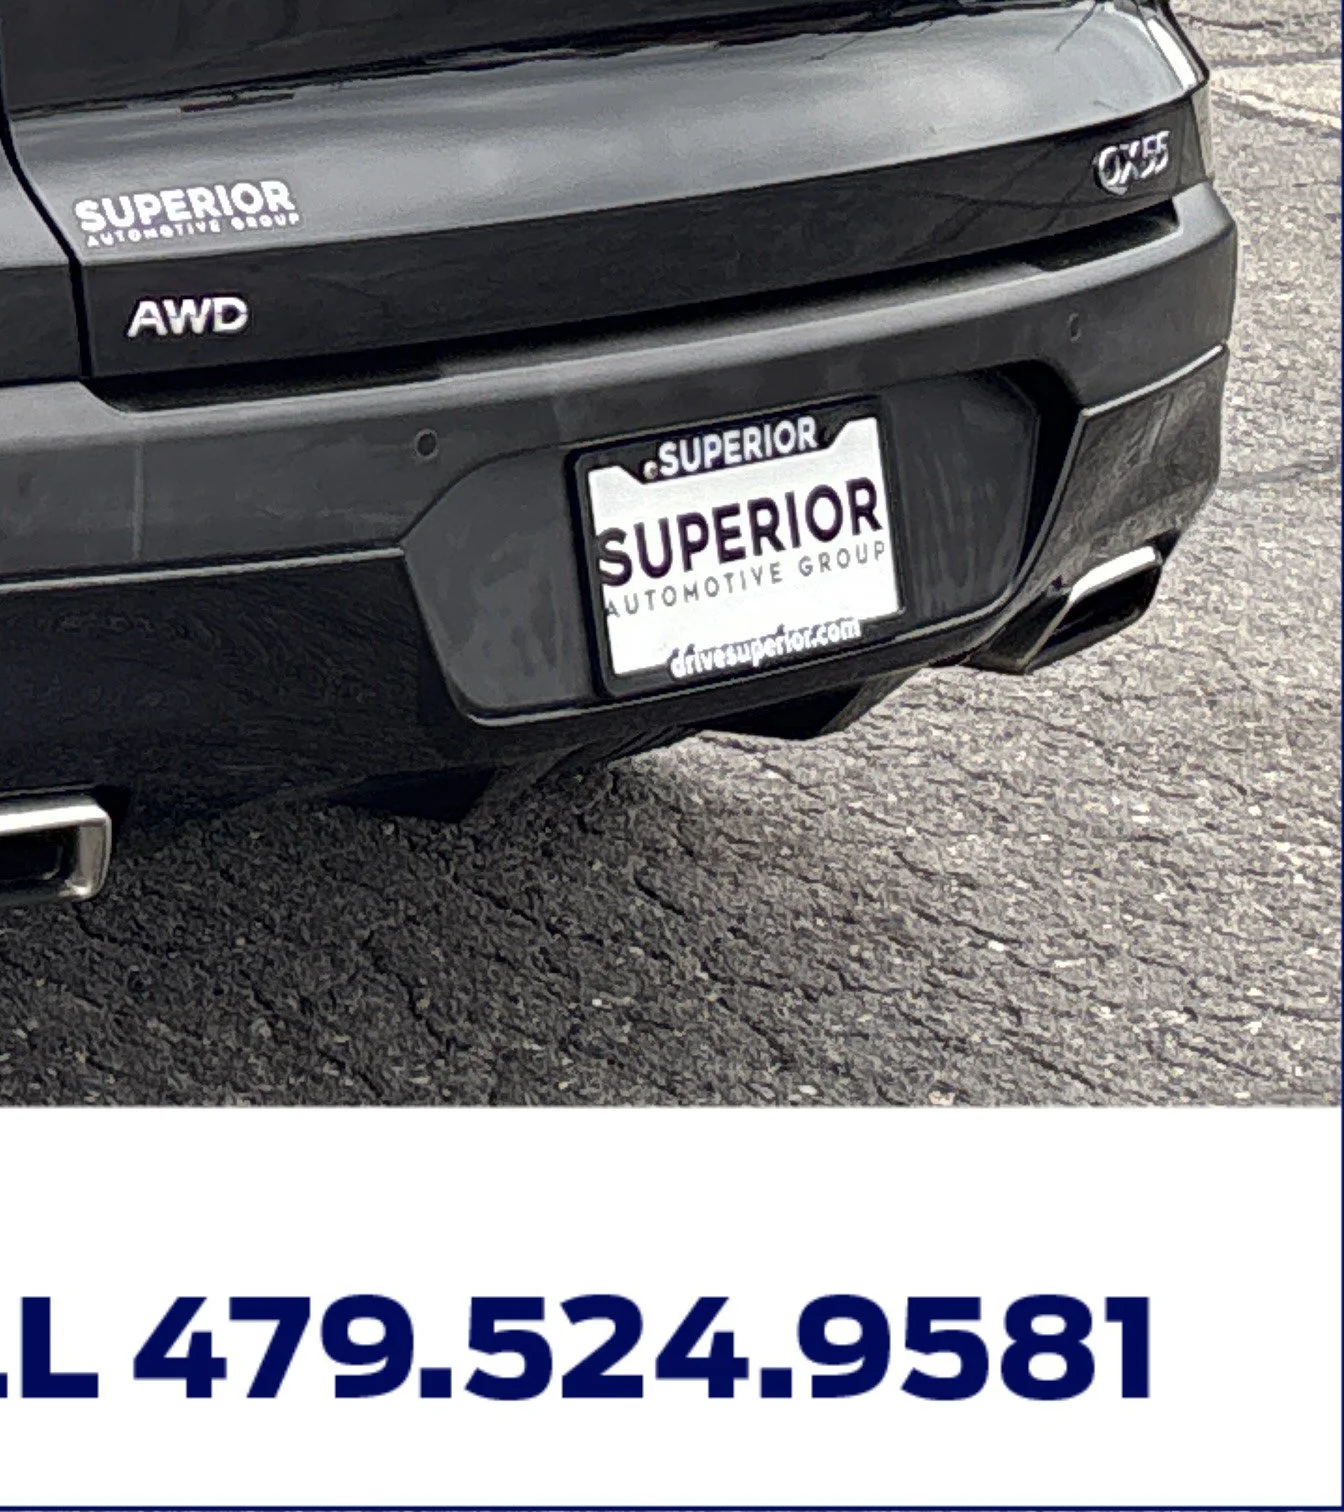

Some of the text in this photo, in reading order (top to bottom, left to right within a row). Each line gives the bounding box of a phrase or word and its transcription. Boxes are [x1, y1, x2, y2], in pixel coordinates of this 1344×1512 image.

[74, 179, 296, 233] SUPERIOR
[86, 211, 301, 249] AUTOMOTIVE GROUP
[125, 295, 250, 339] AWD
[658, 415, 818, 478] SUPERIOR
[594, 475, 883, 587] SUPERIOR
[604, 539, 886, 619] AUTOMOTIVE GROUP
[668, 615, 864, 680] drivesuperior.com
